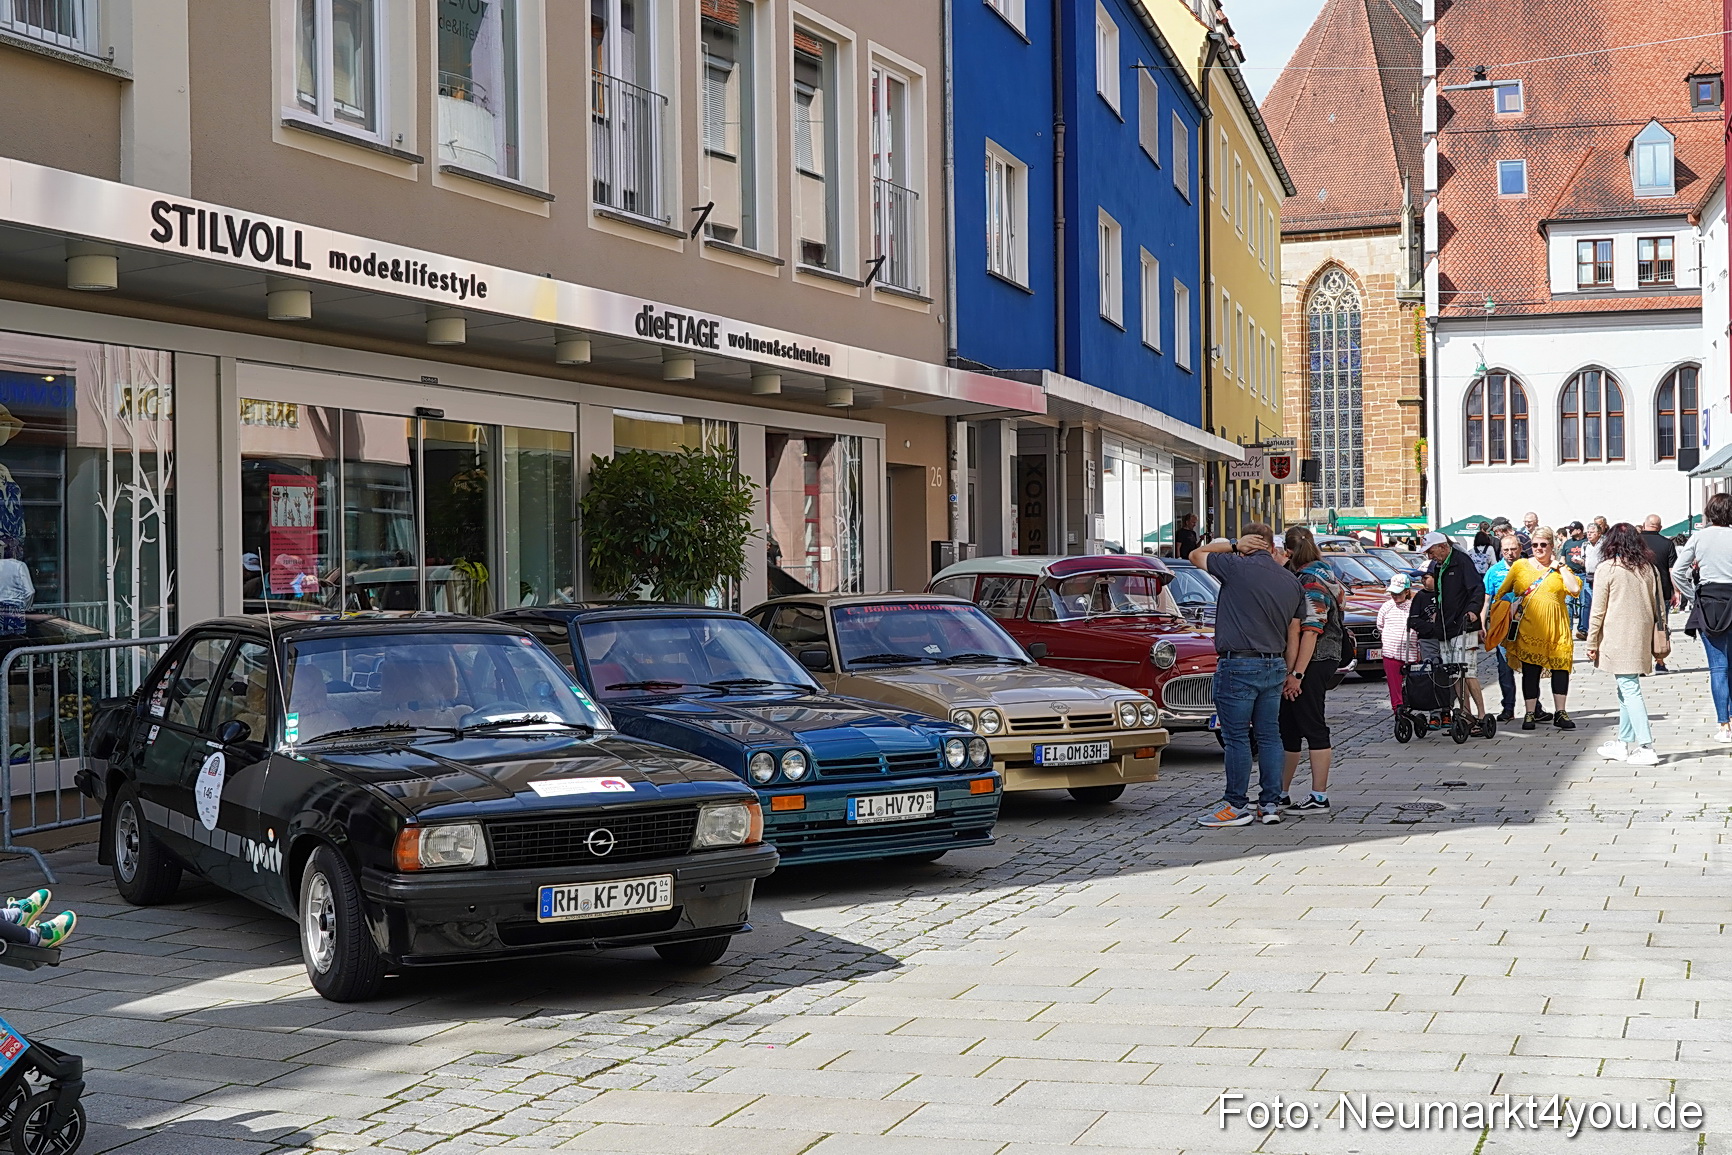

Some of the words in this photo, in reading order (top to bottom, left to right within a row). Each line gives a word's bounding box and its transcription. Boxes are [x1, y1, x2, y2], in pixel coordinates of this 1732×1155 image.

[150, 200, 311, 271] STILVOLL
[329, 250, 487, 300] mode&lifestyle
[635, 304, 720, 350] dieETAGE
[728, 332, 831, 367] wohnen&schenken
[931, 466, 942, 487] 26
[1025, 462, 1043, 518] BOX
[1044, 747, 1058, 761] EI
[1083, 744, 1102, 759] 83H
[857, 799, 874, 817] EI
[885, 796, 904, 814] HV
[907, 794, 924, 812] 79
[554, 889, 578, 913] RH
[594, 885, 619, 909] KF
[624, 881, 657, 906] 990
